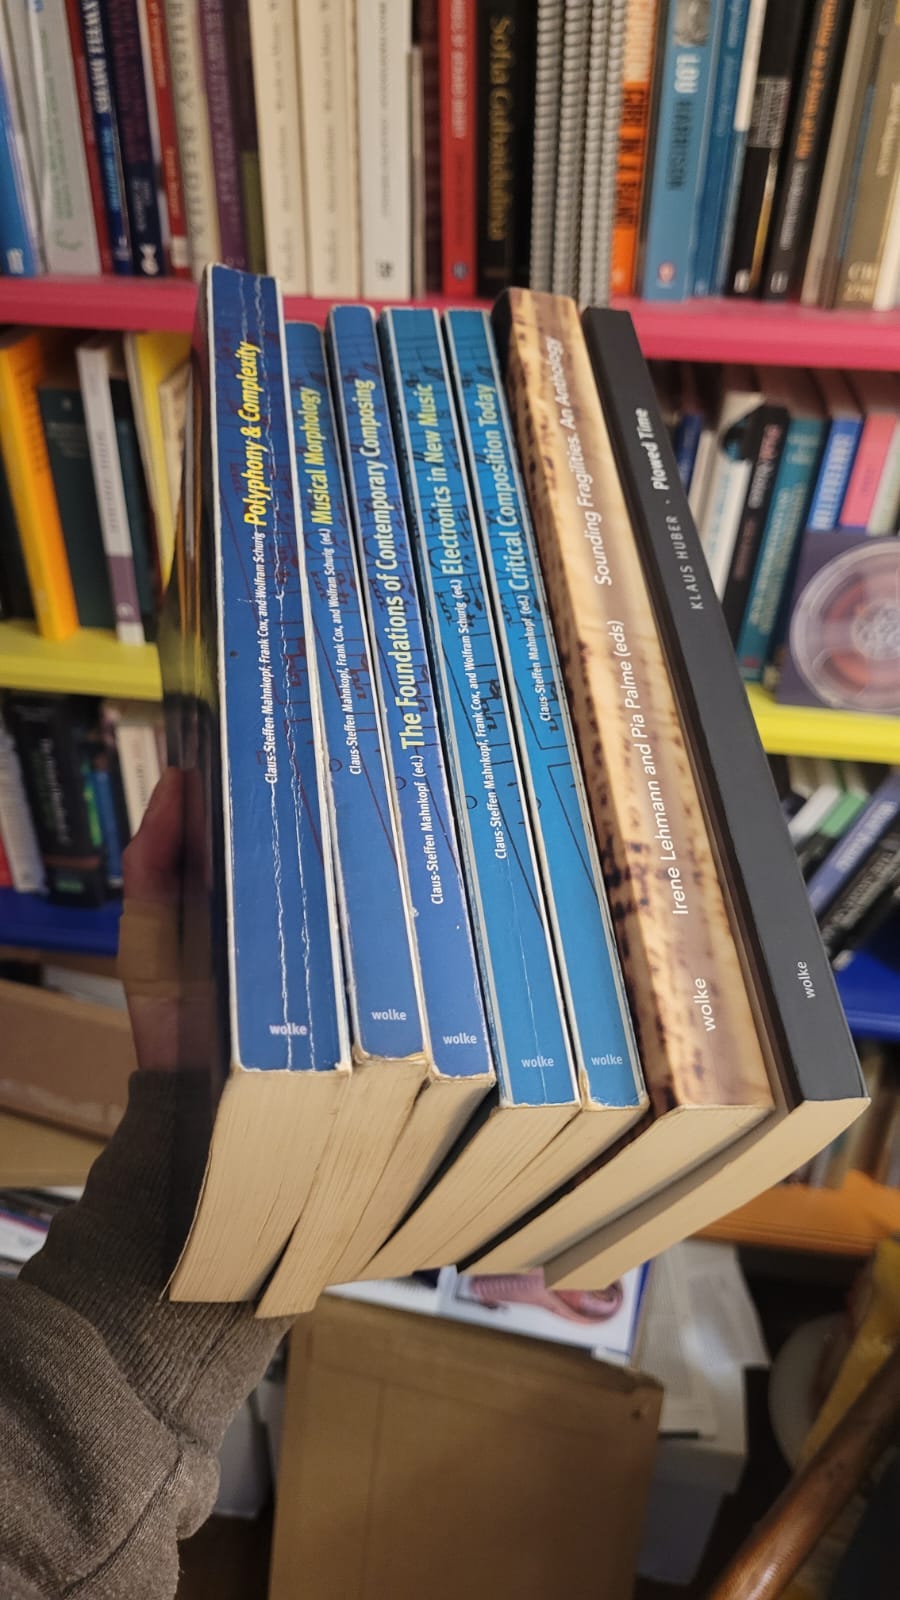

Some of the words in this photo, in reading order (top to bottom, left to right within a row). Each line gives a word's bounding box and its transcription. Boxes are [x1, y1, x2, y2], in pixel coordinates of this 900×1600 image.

[489, 16, 515, 85] Sofia
[674, 54, 701, 94] LOU
[235, 341, 265, 422] Complexity
[546, 336, 570, 406] Anthology
[352, 378, 381, 457] Composing
[414, 384, 438, 426] Music
[475, 384, 498, 426] Today
[560, 408, 577, 430] An
[636, 407, 655, 440] Time
[240, 426, 262, 439] &
[298, 387, 326, 466] Morphology
[424, 430, 444, 463] New
[641, 440, 669, 490] Plowed
[243, 440, 271, 526] Polyphony
[427, 466, 448, 482] in
[484, 430, 517, 526] Composition
[566, 432, 594, 507] Fragilities.
[305, 470, 333, 524] Musical
[366, 460, 398, 569] Contemporary
[252, 532, 266, 562] Schurig
[320, 528, 333, 544] (ed.)
[432, 484, 464, 574] Electronics
[583, 509, 612, 586] Sounding
[666, 516, 688, 559] HUBER
[321, 546, 335, 576] Schurig
[498, 531, 530, 591] Critical
[254, 563, 267, 600] Wolfram
[324, 576, 338, 608] Wolfram
[377, 572, 400, 592] of
[451, 580, 463, 599] (ed.)
[680, 566, 703, 610] KLAUS
[256, 601, 268, 618] and
[328, 608, 341, 624] and
[455, 599, 470, 634] Schurig
[518, 594, 530, 615] (ed.)
[257, 617, 269, 637] Cox,
[332, 625, 344, 642] Cox,
[521, 617, 539, 662] Mahnkopf
[607, 620, 631, 657] (eds)
[259, 638, 271, 661] Frank
[336, 642, 347, 666] Frank
[384, 593, 418, 714] Foundations
[460, 634, 476, 672] Wolfram
[258, 663, 274, 714] Mahnkopf,
[336, 668, 353, 712] Mahnkopf,
[465, 672, 478, 689] and
[529, 661, 552, 721] Claus-Steffen
[618, 660, 640, 709] Palme
[469, 691, 482, 711] Cox,
[342, 714, 361, 775] Claus-Steffen
[400, 716, 425, 749] The
[471, 712, 485, 739] Frank
[630, 713, 645, 737] Pia
[262, 717, 278, 784] Claus-Steffen
[410, 755, 425, 778] (ed.)
[477, 740, 496, 791] Mahnkopf,
[634, 741, 656, 776] and
[414, 782, 432, 832] Mahnkopf
[482, 790, 507, 859] Claus-Steffen
[648, 780, 676, 860] Lehmann
[420, 833, 444, 904] Claus-Steffen
[668, 866, 688, 915] Irene
[798, 960, 816, 999] wolke
[371, 1008, 407, 1021] wolke
[692, 976, 716, 1032] wolke
[270, 1022, 308, 1036] wolke
[442, 1033, 478, 1046] wolke
[521, 1056, 555, 1069] wolke
[591, 1054, 623, 1066] wolke
